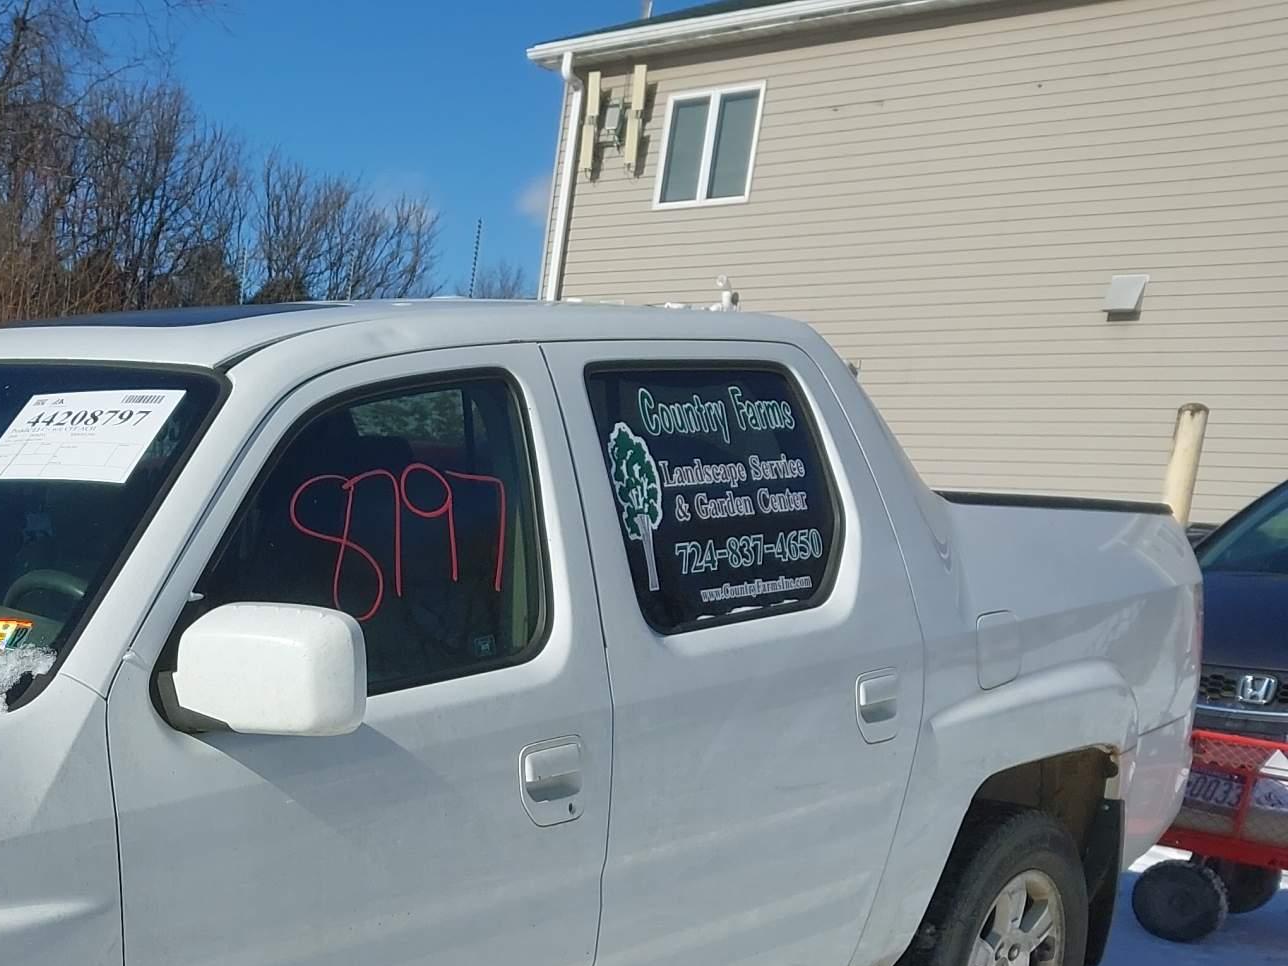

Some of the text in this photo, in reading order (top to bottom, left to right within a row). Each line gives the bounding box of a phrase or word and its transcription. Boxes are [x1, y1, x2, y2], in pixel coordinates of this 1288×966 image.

[27, 410, 152, 427] 44208797
[637, 386, 795, 444] Country Farms
[660, 454, 805, 487] Landscape Service
[675, 488, 807, 522] & Garden Center
[290, 462, 507, 621] 8797
[675, 529, 823, 575] 724-837-4650
[700, 576, 812, 602] www.CountryFarmsInc.com
